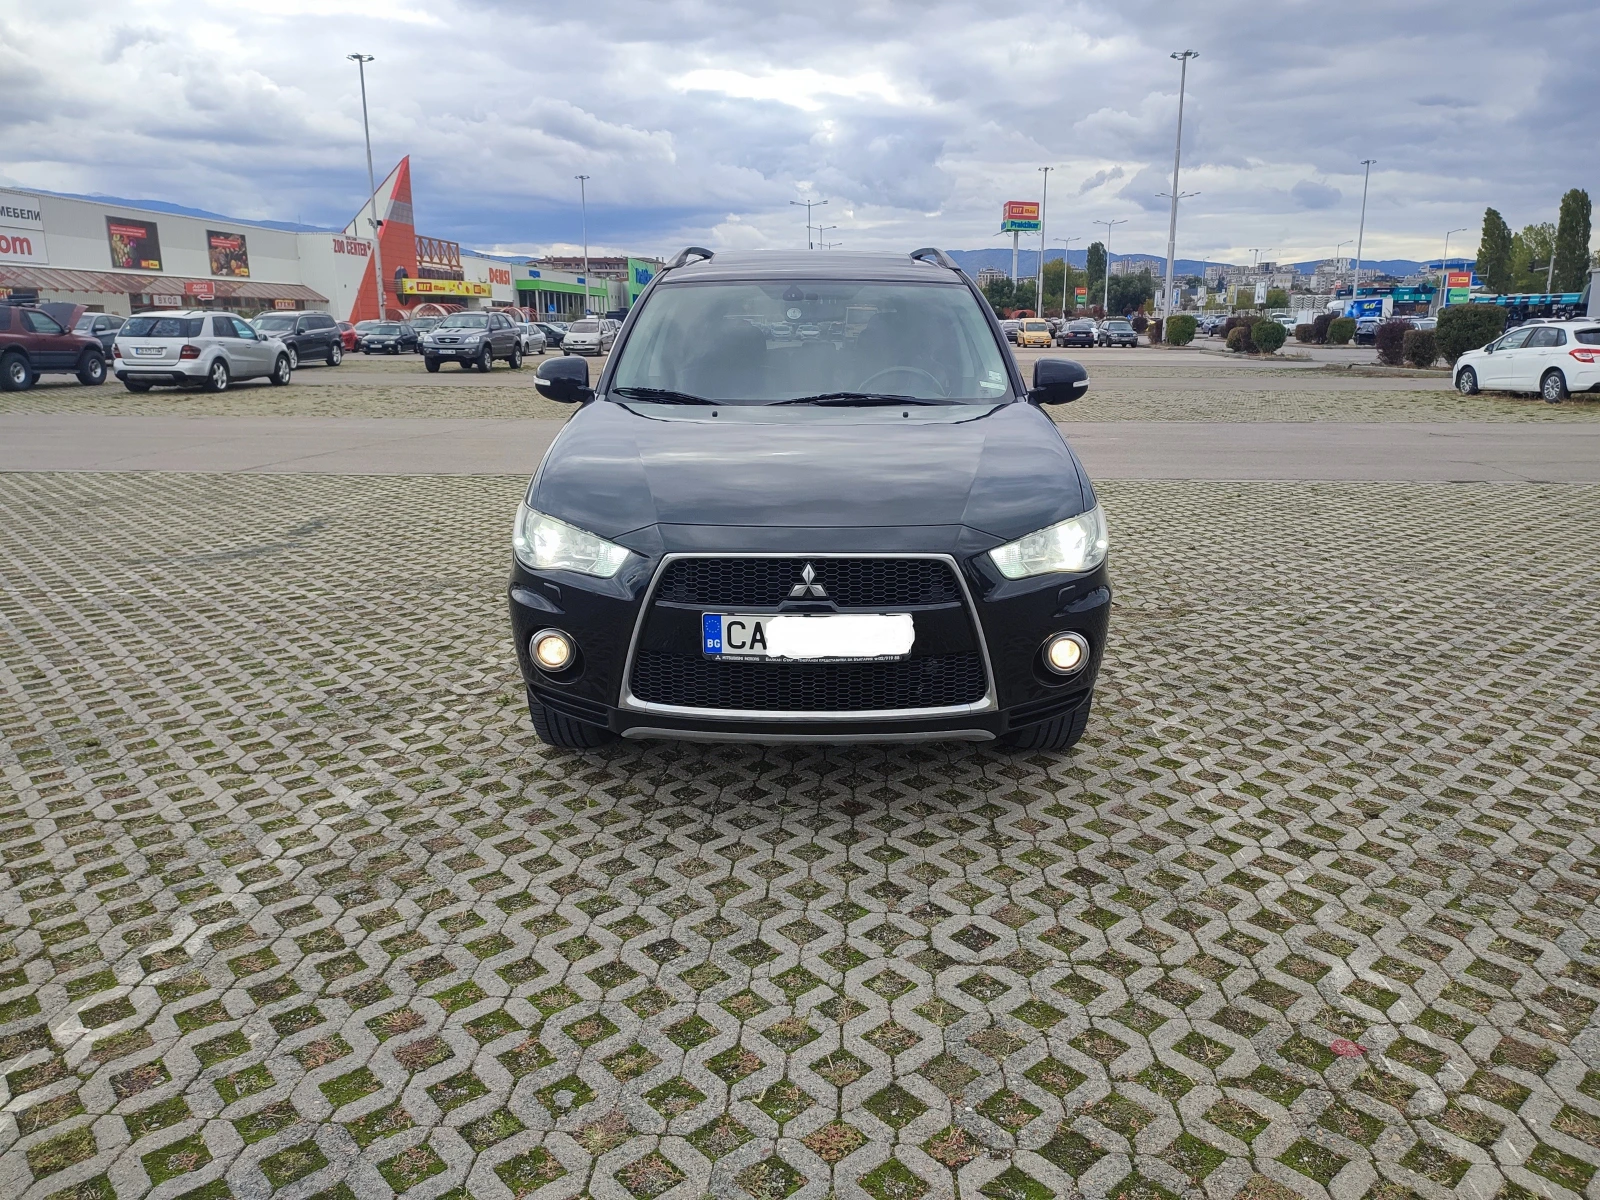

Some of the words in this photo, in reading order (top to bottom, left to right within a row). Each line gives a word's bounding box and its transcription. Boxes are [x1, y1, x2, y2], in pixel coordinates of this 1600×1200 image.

[1010, 220, 1039, 229] Praktiker
[333, 239, 345, 254] ZOO
[346, 241, 368, 257] CENTER
[489, 268, 510, 285] DENSI
[418, 283, 431, 291] HIT
[158, 296, 178, 305] ВХОД
[707, 639, 720, 648] BG
